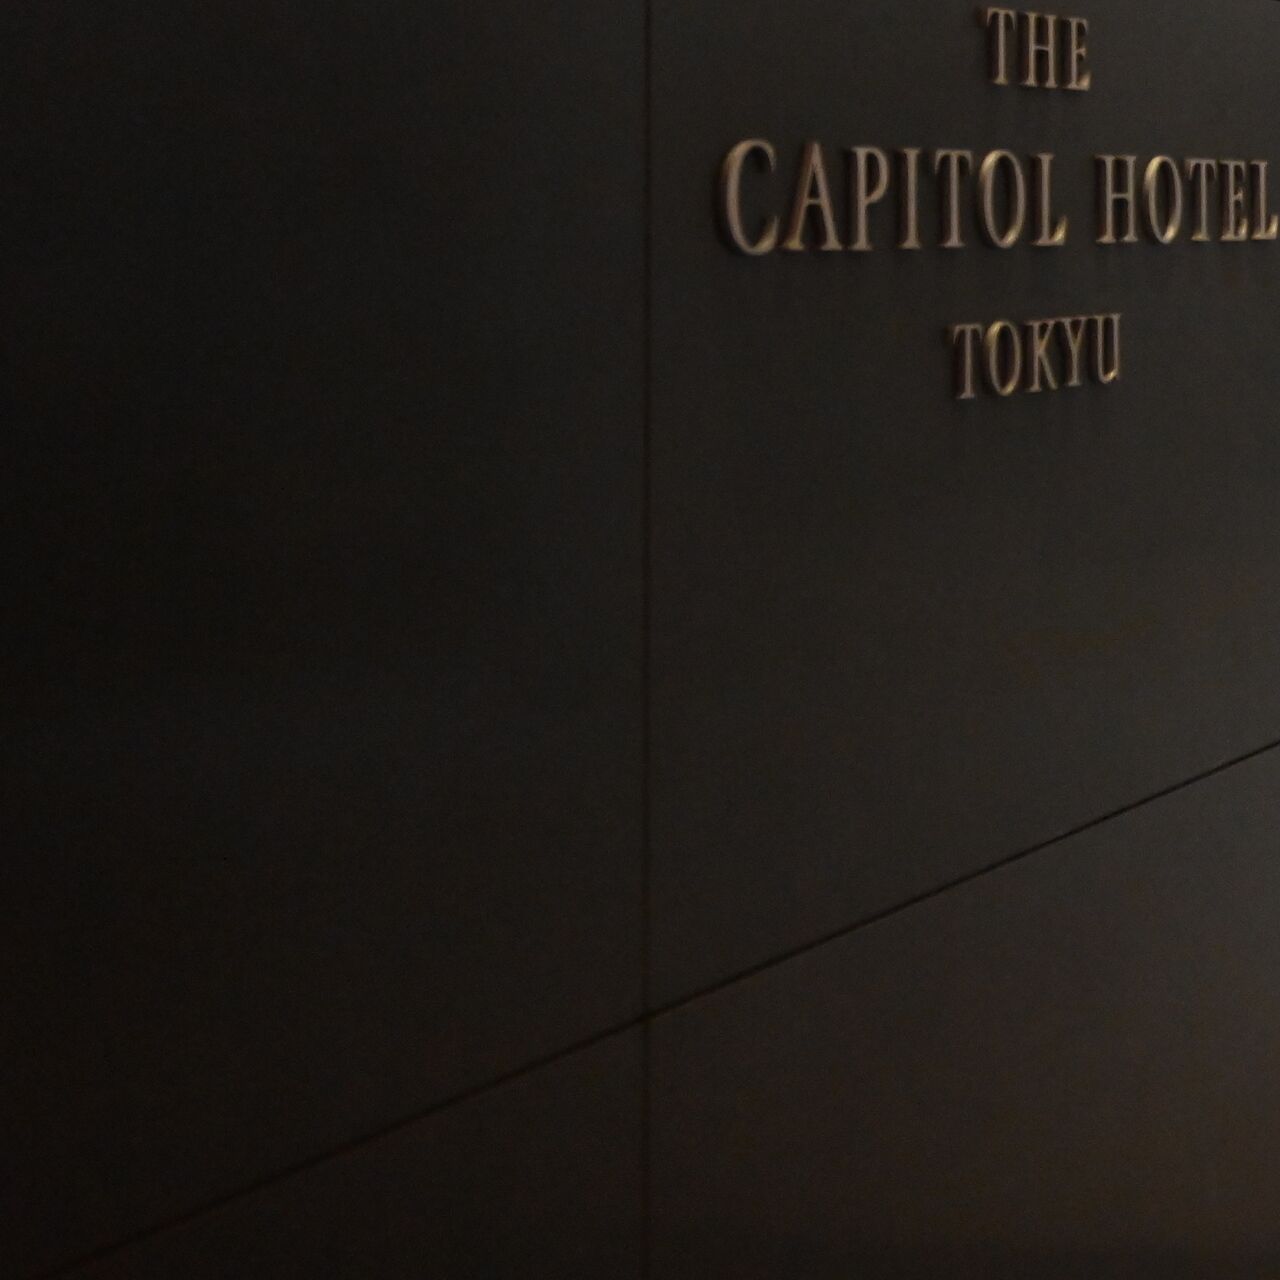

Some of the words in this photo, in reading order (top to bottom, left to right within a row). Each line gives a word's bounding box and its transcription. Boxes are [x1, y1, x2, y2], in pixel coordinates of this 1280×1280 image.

[984, 6, 1092, 91] THE
[721, 138, 1068, 256] CAPITOL
[1095, 154, 1280, 245] HOTEL
[951, 313, 1122, 400] TOKYU
